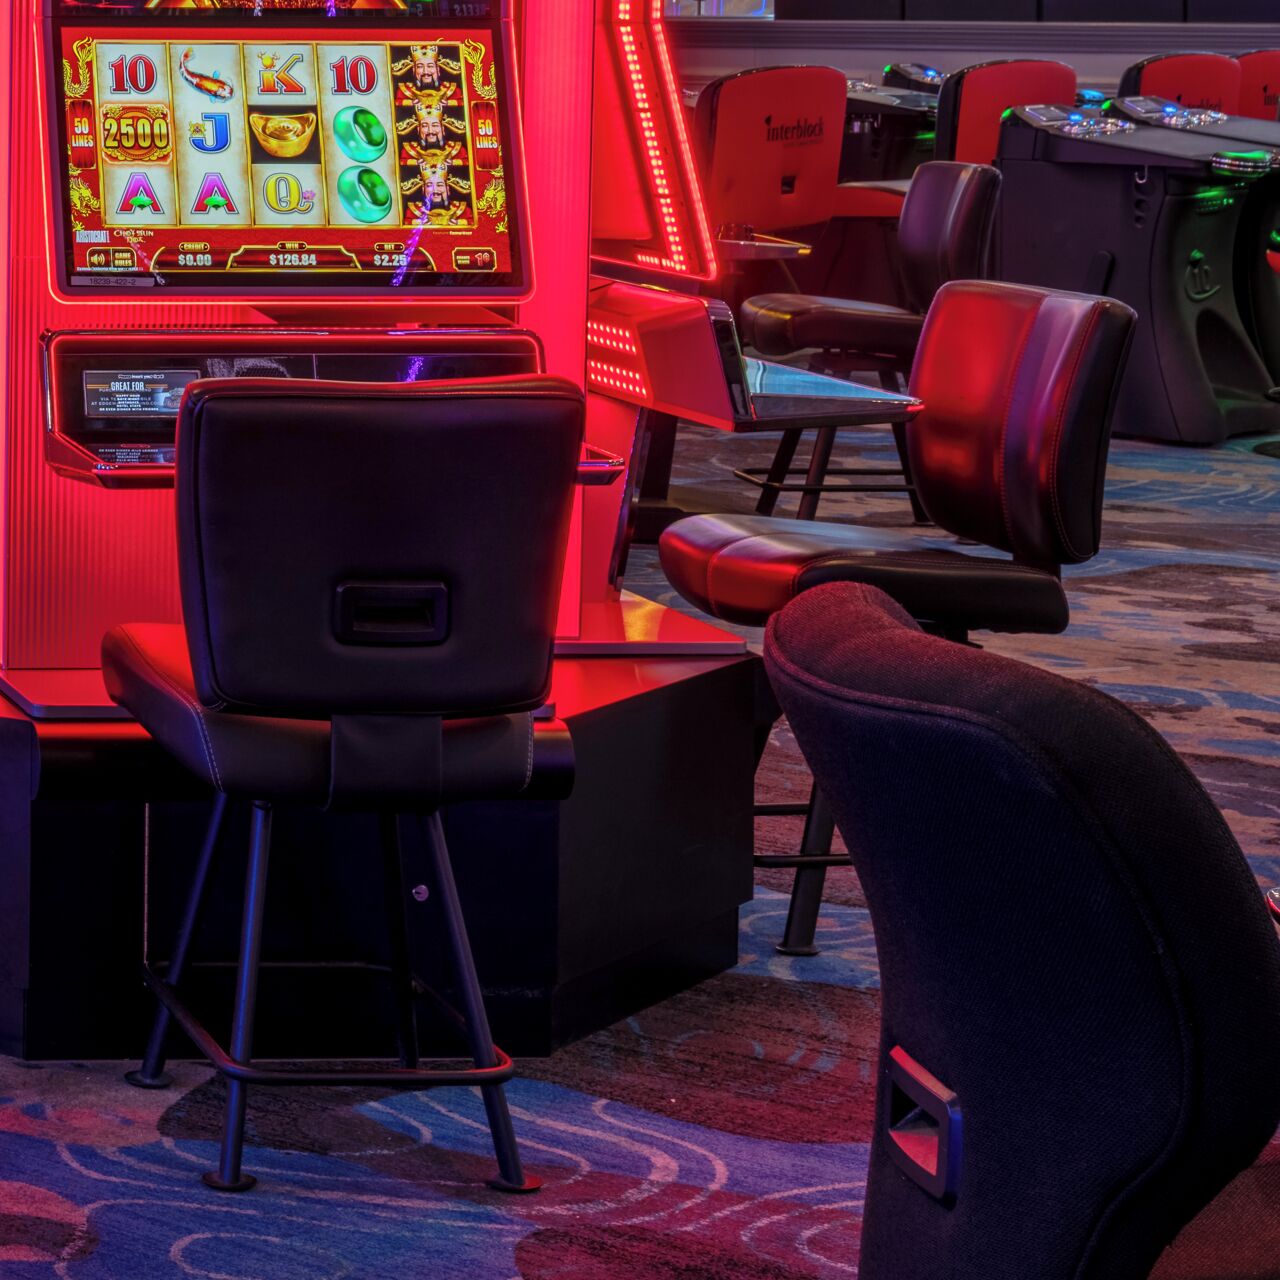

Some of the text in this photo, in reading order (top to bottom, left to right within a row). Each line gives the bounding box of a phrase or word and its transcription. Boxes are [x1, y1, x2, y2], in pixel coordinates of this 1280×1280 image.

[108, 53, 378, 95] 10 K 10
[74, 112, 493, 154] 50 2500 J 50
[766, 116, 824, 142] interblock
[71, 133, 498, 150] LINES LINES
[116, 171, 315, 215] A A Q
[285, 242, 300, 250] WIN
[178, 253, 212, 266] $0.00
[269, 253, 317, 266] $126.84
[373, 254, 407, 267] $2.25
[110, 381, 145, 391] GREAT FOR
